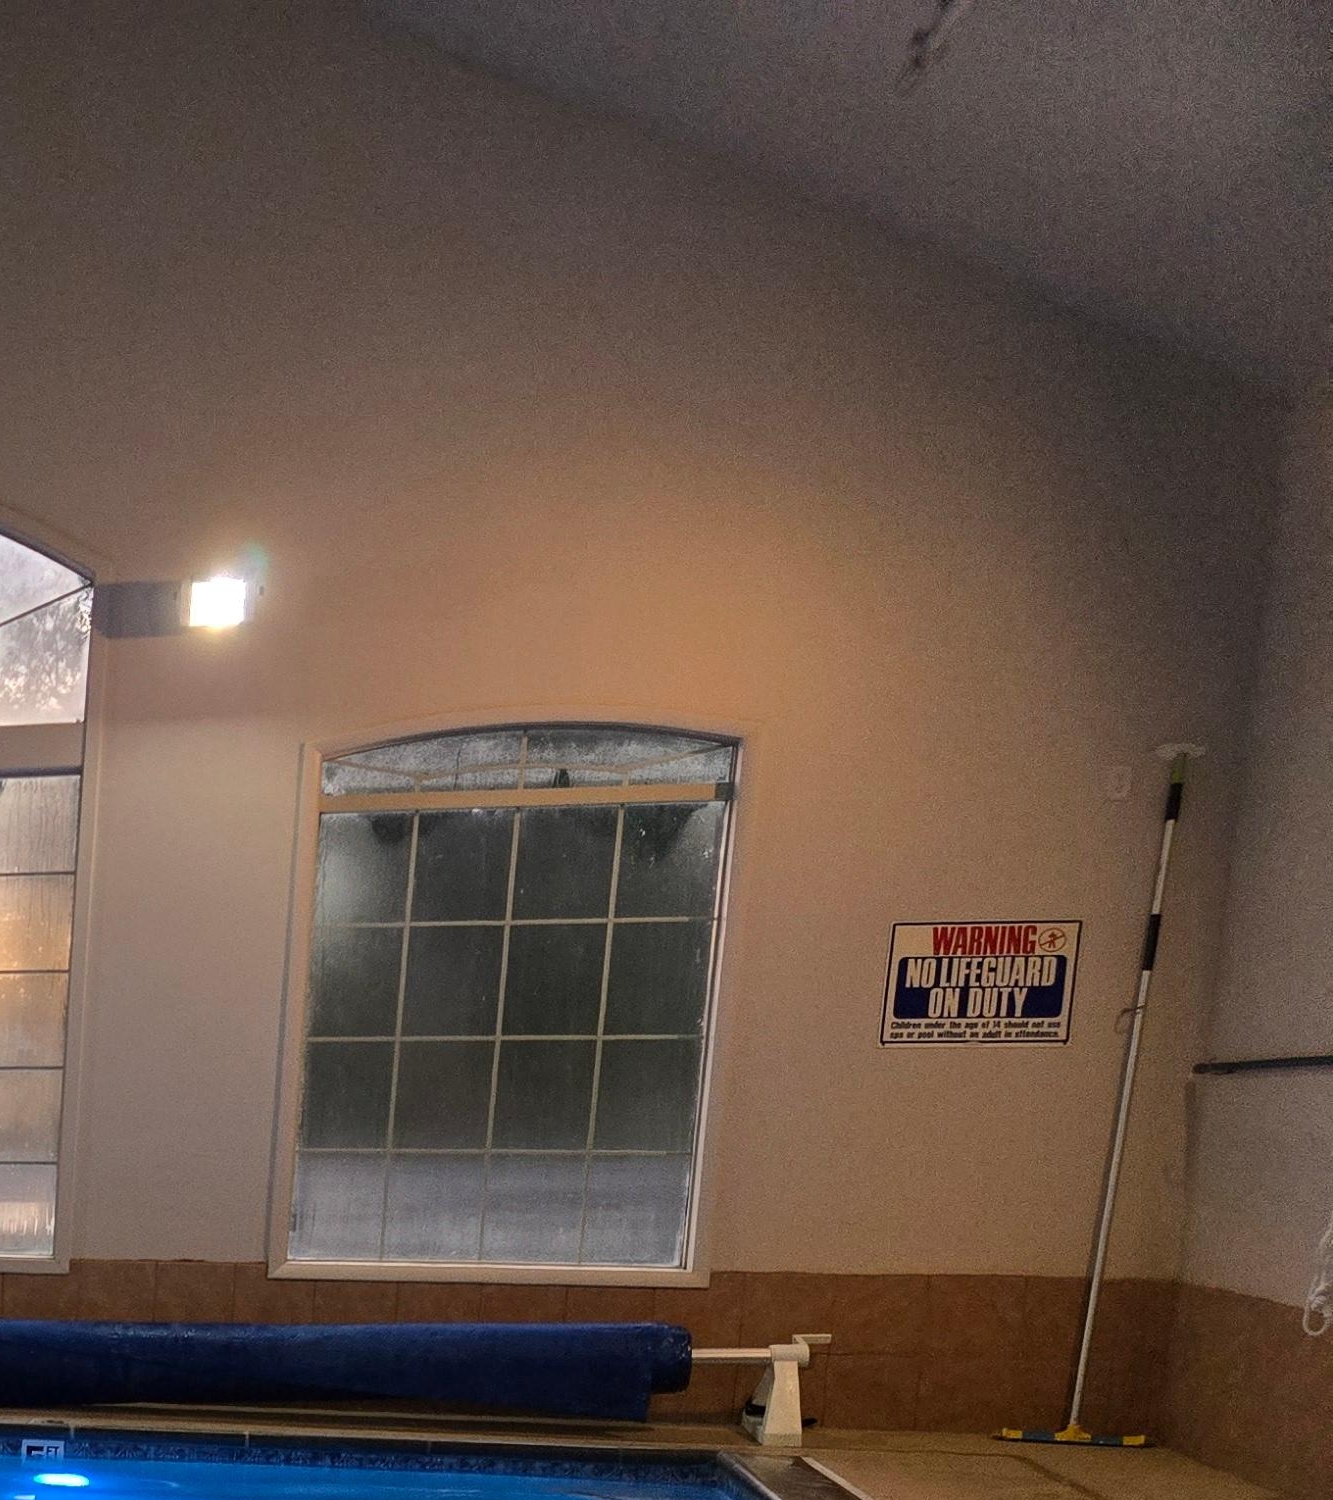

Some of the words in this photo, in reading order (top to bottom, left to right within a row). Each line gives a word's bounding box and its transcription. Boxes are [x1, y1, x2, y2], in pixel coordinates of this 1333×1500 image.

[932, 925, 1037, 955] WARNING
[905, 958, 936, 988] NO
[939, 956, 1058, 987] LIFEGUARD
[928, 987, 960, 1018] ON
[966, 987, 1028, 1018] DUTY
[891, 1021, 921, 1029] Children
[924, 1021, 945, 1029] under
[949, 1021, 961, 1029] the
[964, 1022, 978, 1030] age
[1004, 1020, 1029, 1028] should
[1031, 1020, 1044, 1028] not
[918, 1031, 934, 1039] pool
[937, 1030, 966, 1038] without
[47, 1446, 60, 1456] FT
